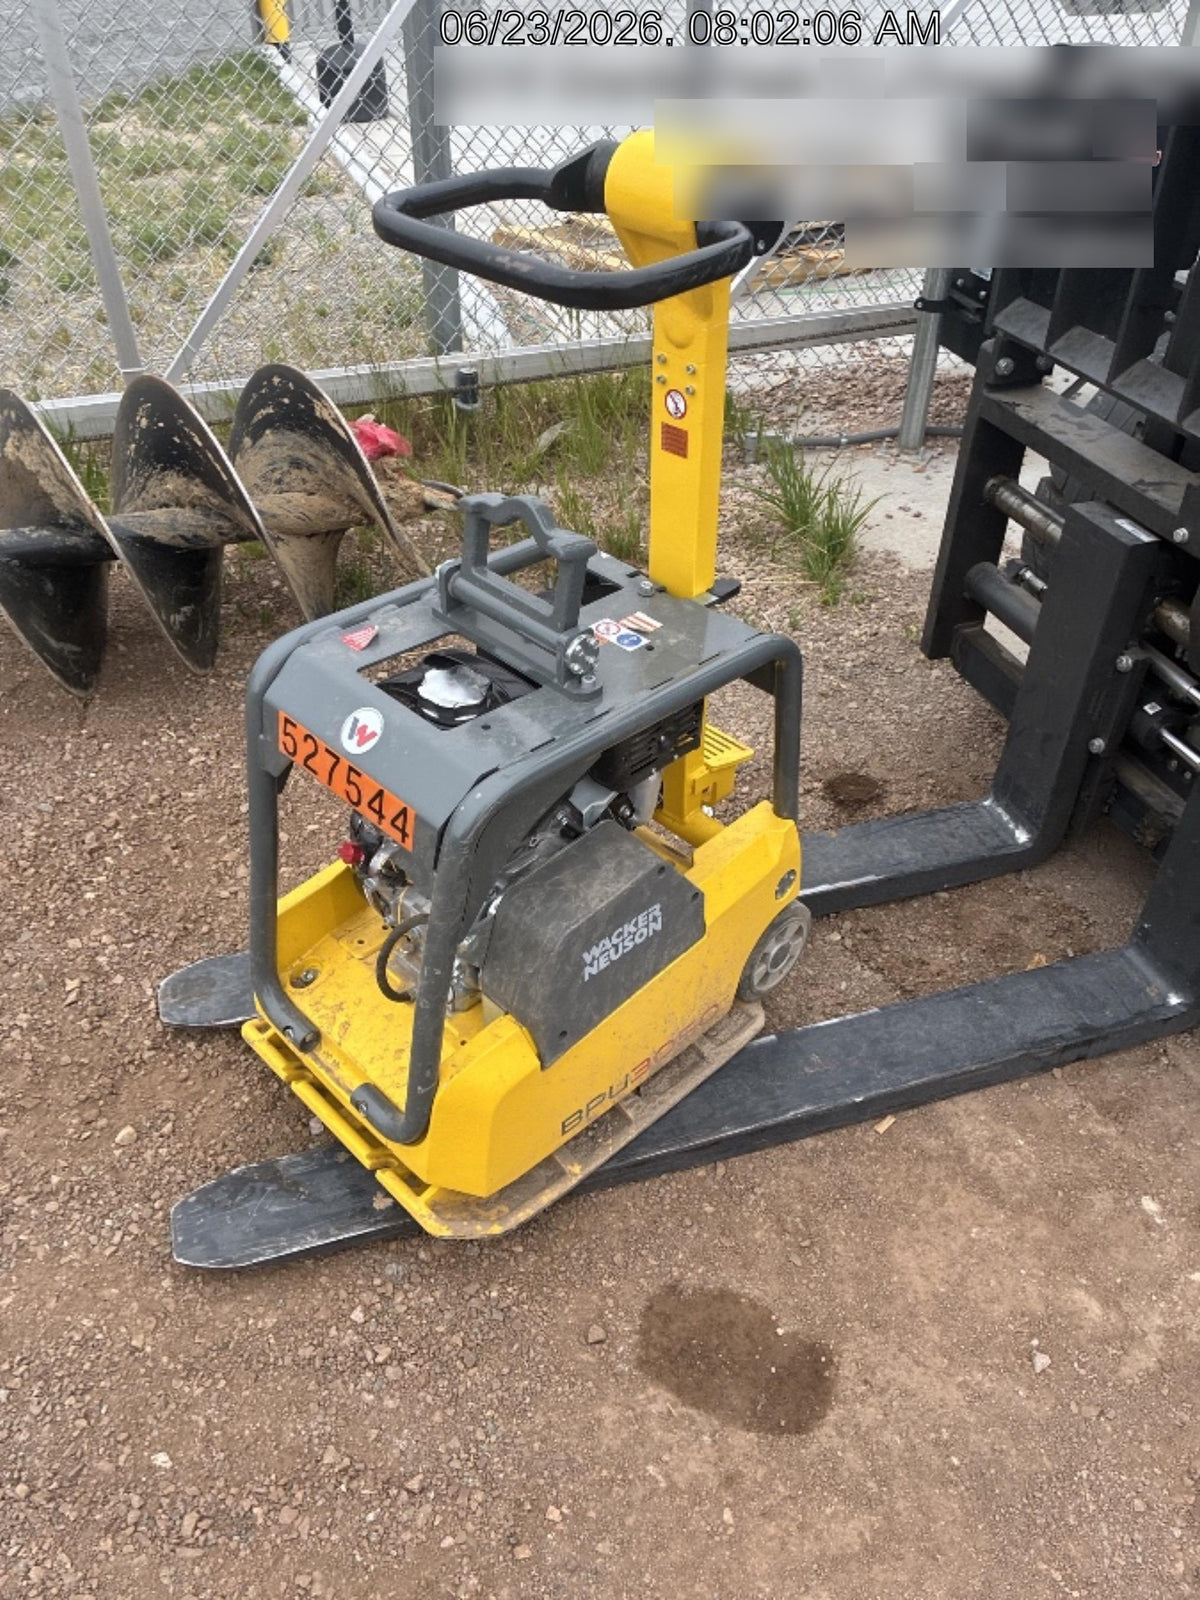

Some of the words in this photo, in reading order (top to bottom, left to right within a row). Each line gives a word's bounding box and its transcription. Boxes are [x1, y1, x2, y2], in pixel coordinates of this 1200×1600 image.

[282, 716, 410, 844] 527544
[582, 903, 662, 965] WACKER
[583, 914, 662, 982] NEUSON
